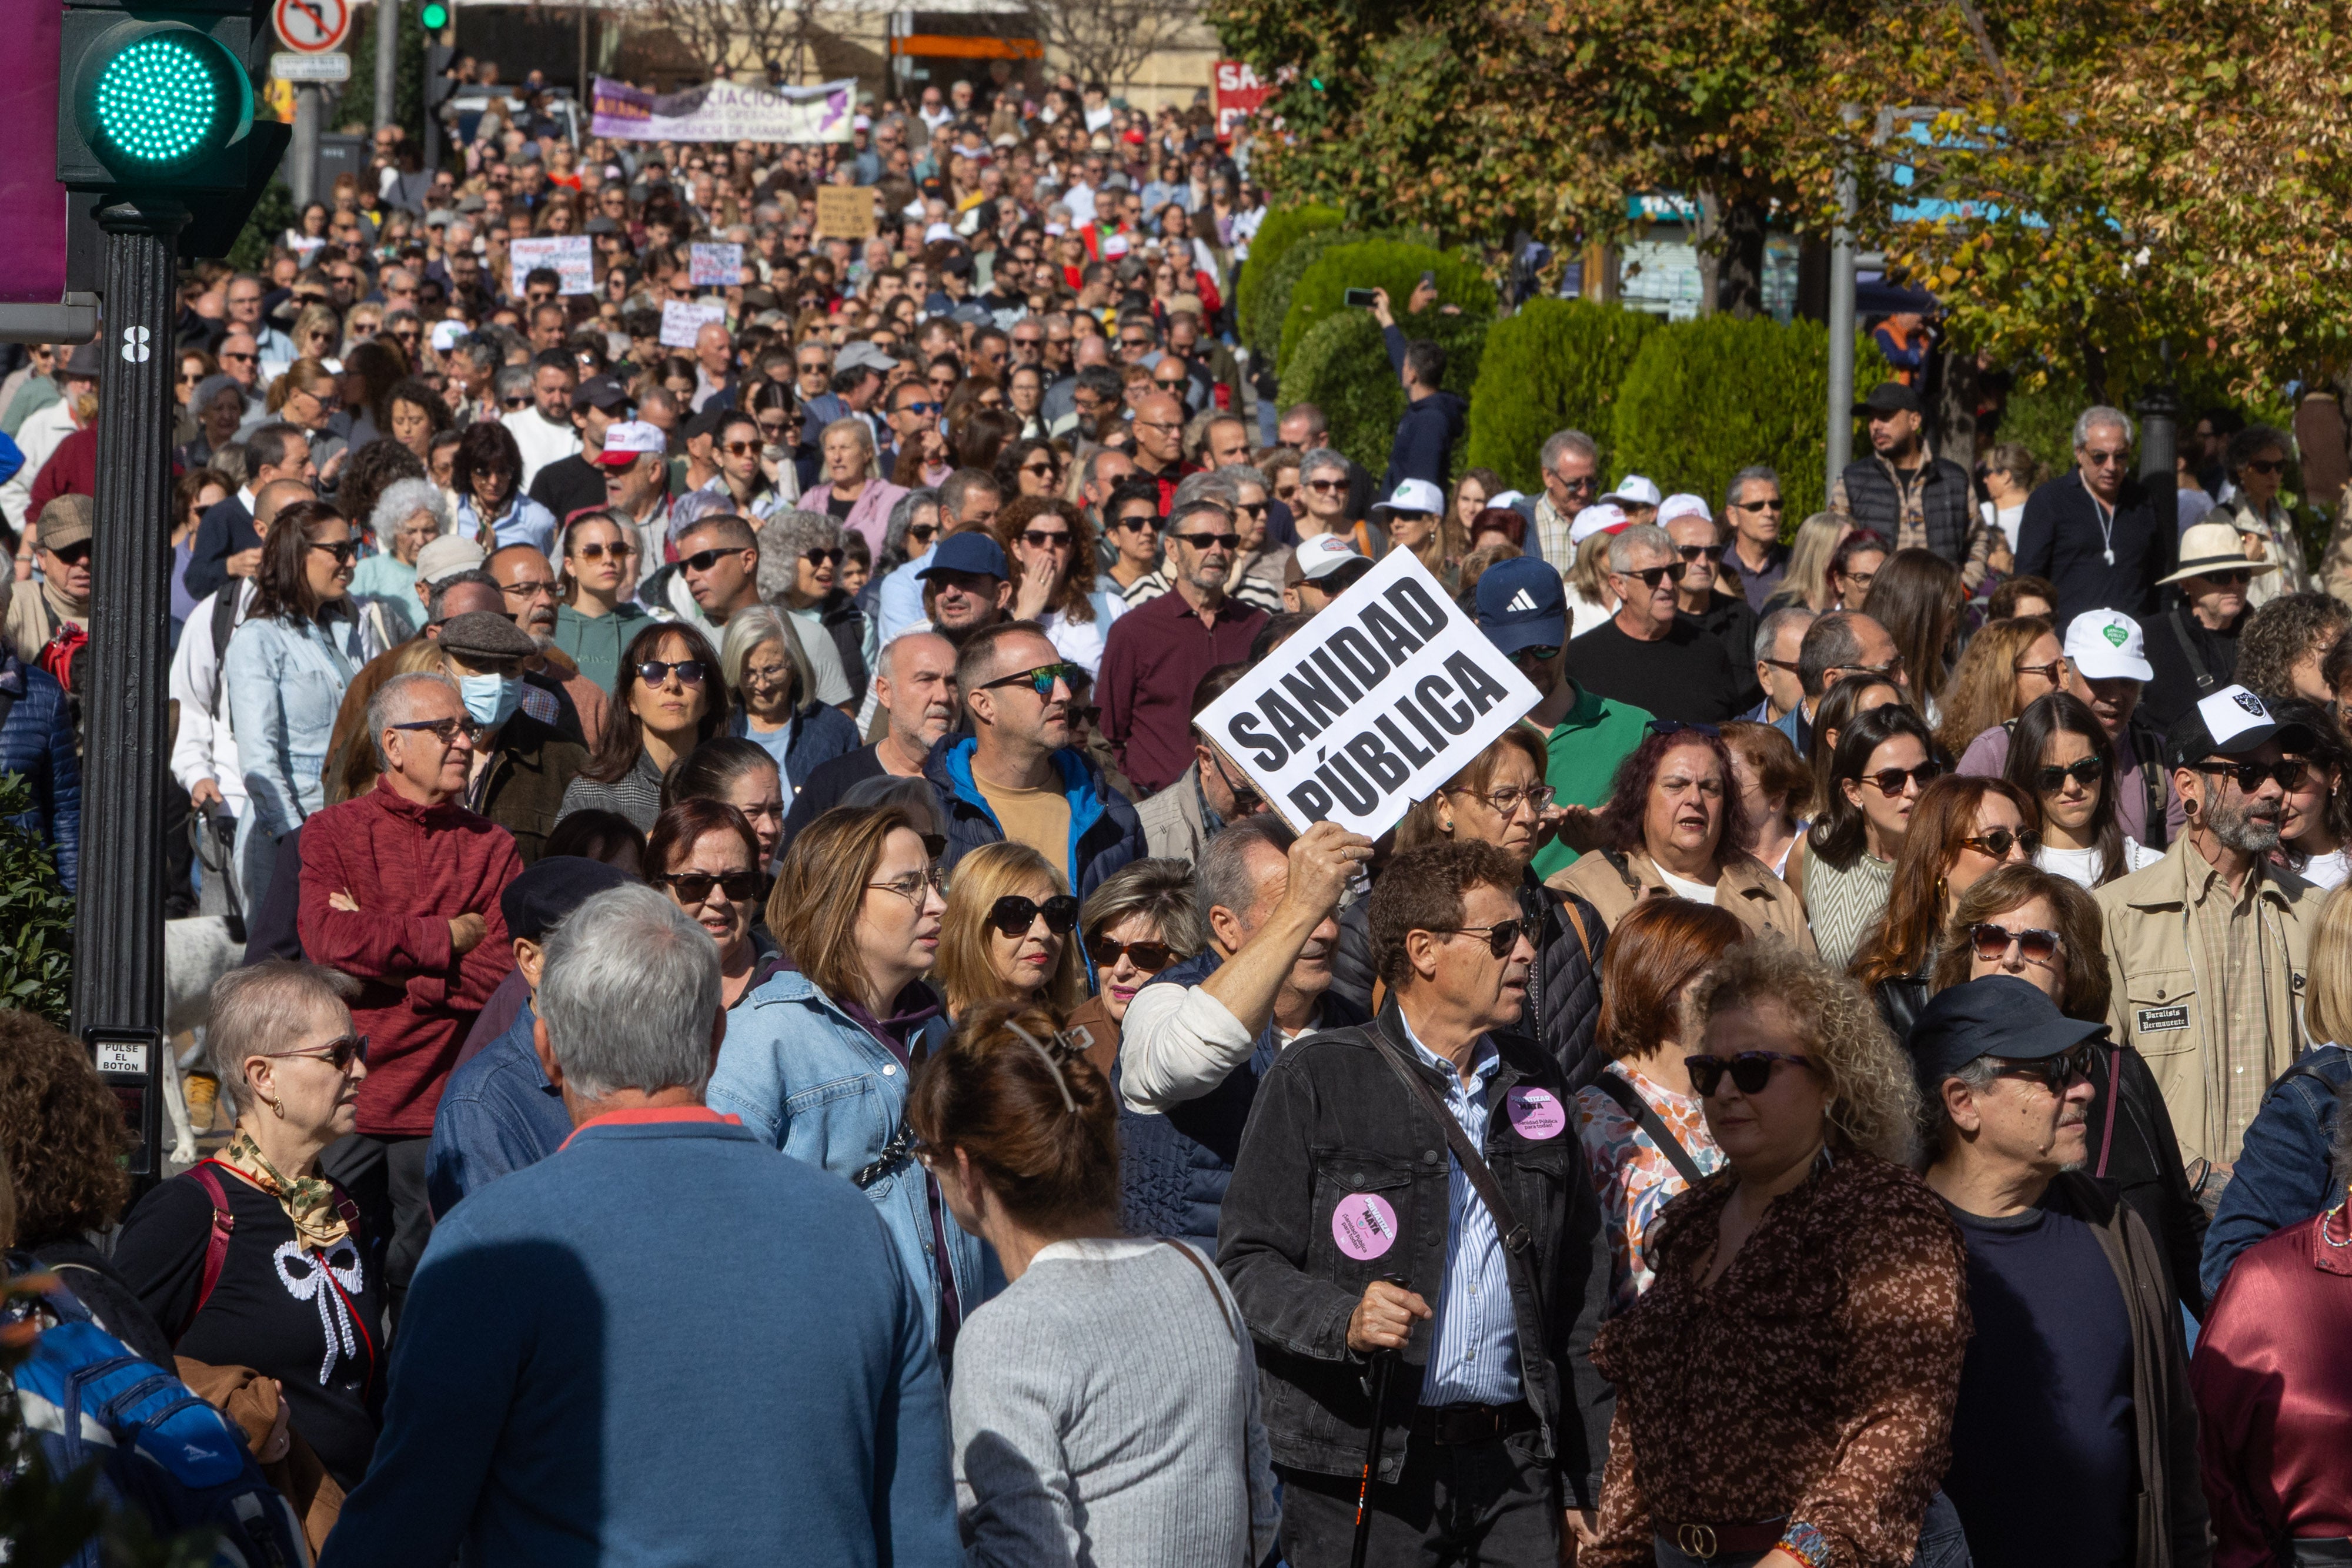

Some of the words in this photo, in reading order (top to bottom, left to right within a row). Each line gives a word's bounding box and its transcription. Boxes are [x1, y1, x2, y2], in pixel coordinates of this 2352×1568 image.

[121, 325, 150, 363] 8
[1228, 576, 1449, 773] SANIDAD
[1287, 650, 1510, 825] PÚBLICA
[105, 1043, 139, 1053] PULSE
[115, 1053, 127, 1061] EL
[103, 1061, 138, 1072] BOTON
[1341, 1222, 1351, 1235] para
[1342, 1213, 1358, 1235] ¡Sanidad
[1355, 1233, 1368, 1253] Pública
[1362, 1210, 1381, 1236] MATA
[1364, 1196, 1394, 1240] PRIVATIZAR
